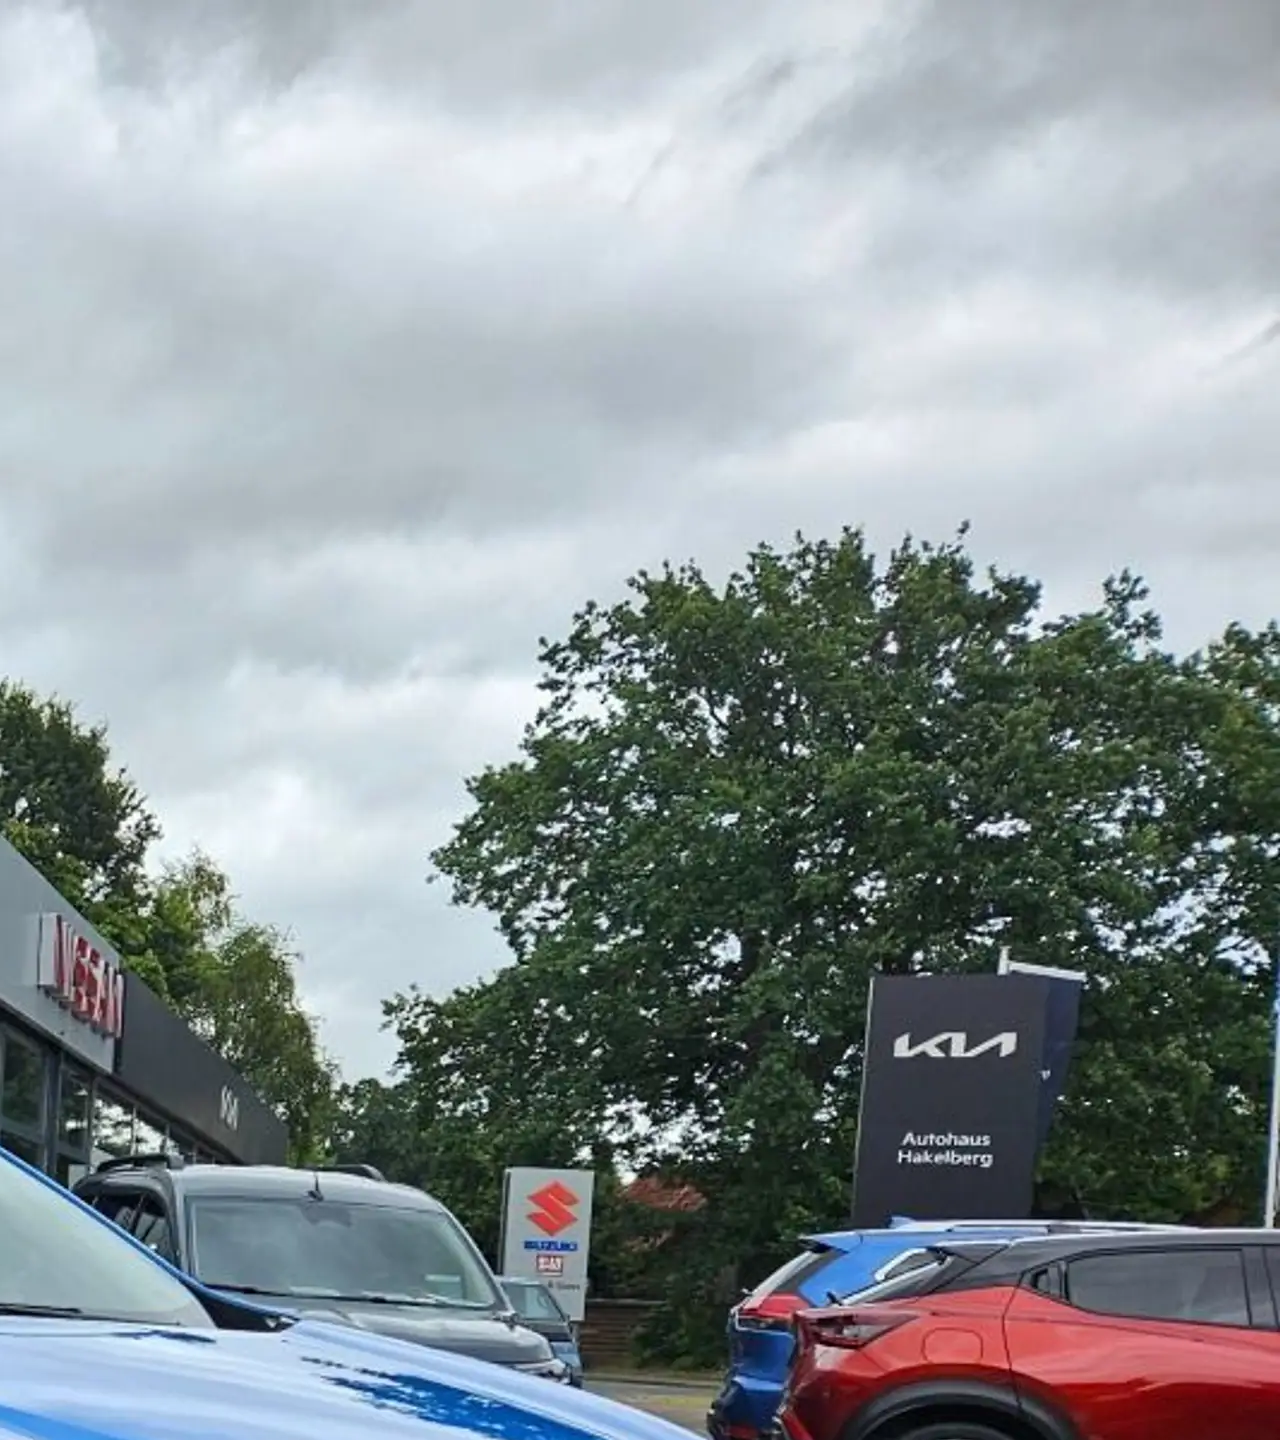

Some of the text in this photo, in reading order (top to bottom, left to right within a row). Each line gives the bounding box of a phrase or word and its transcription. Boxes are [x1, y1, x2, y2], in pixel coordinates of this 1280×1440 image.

[893, 1032, 1017, 1057] KIA
[902, 1131, 991, 1146] Autohaus
[897, 1149, 994, 1168] Hakelberg
[524, 1241, 578, 1251] SUZUKI
